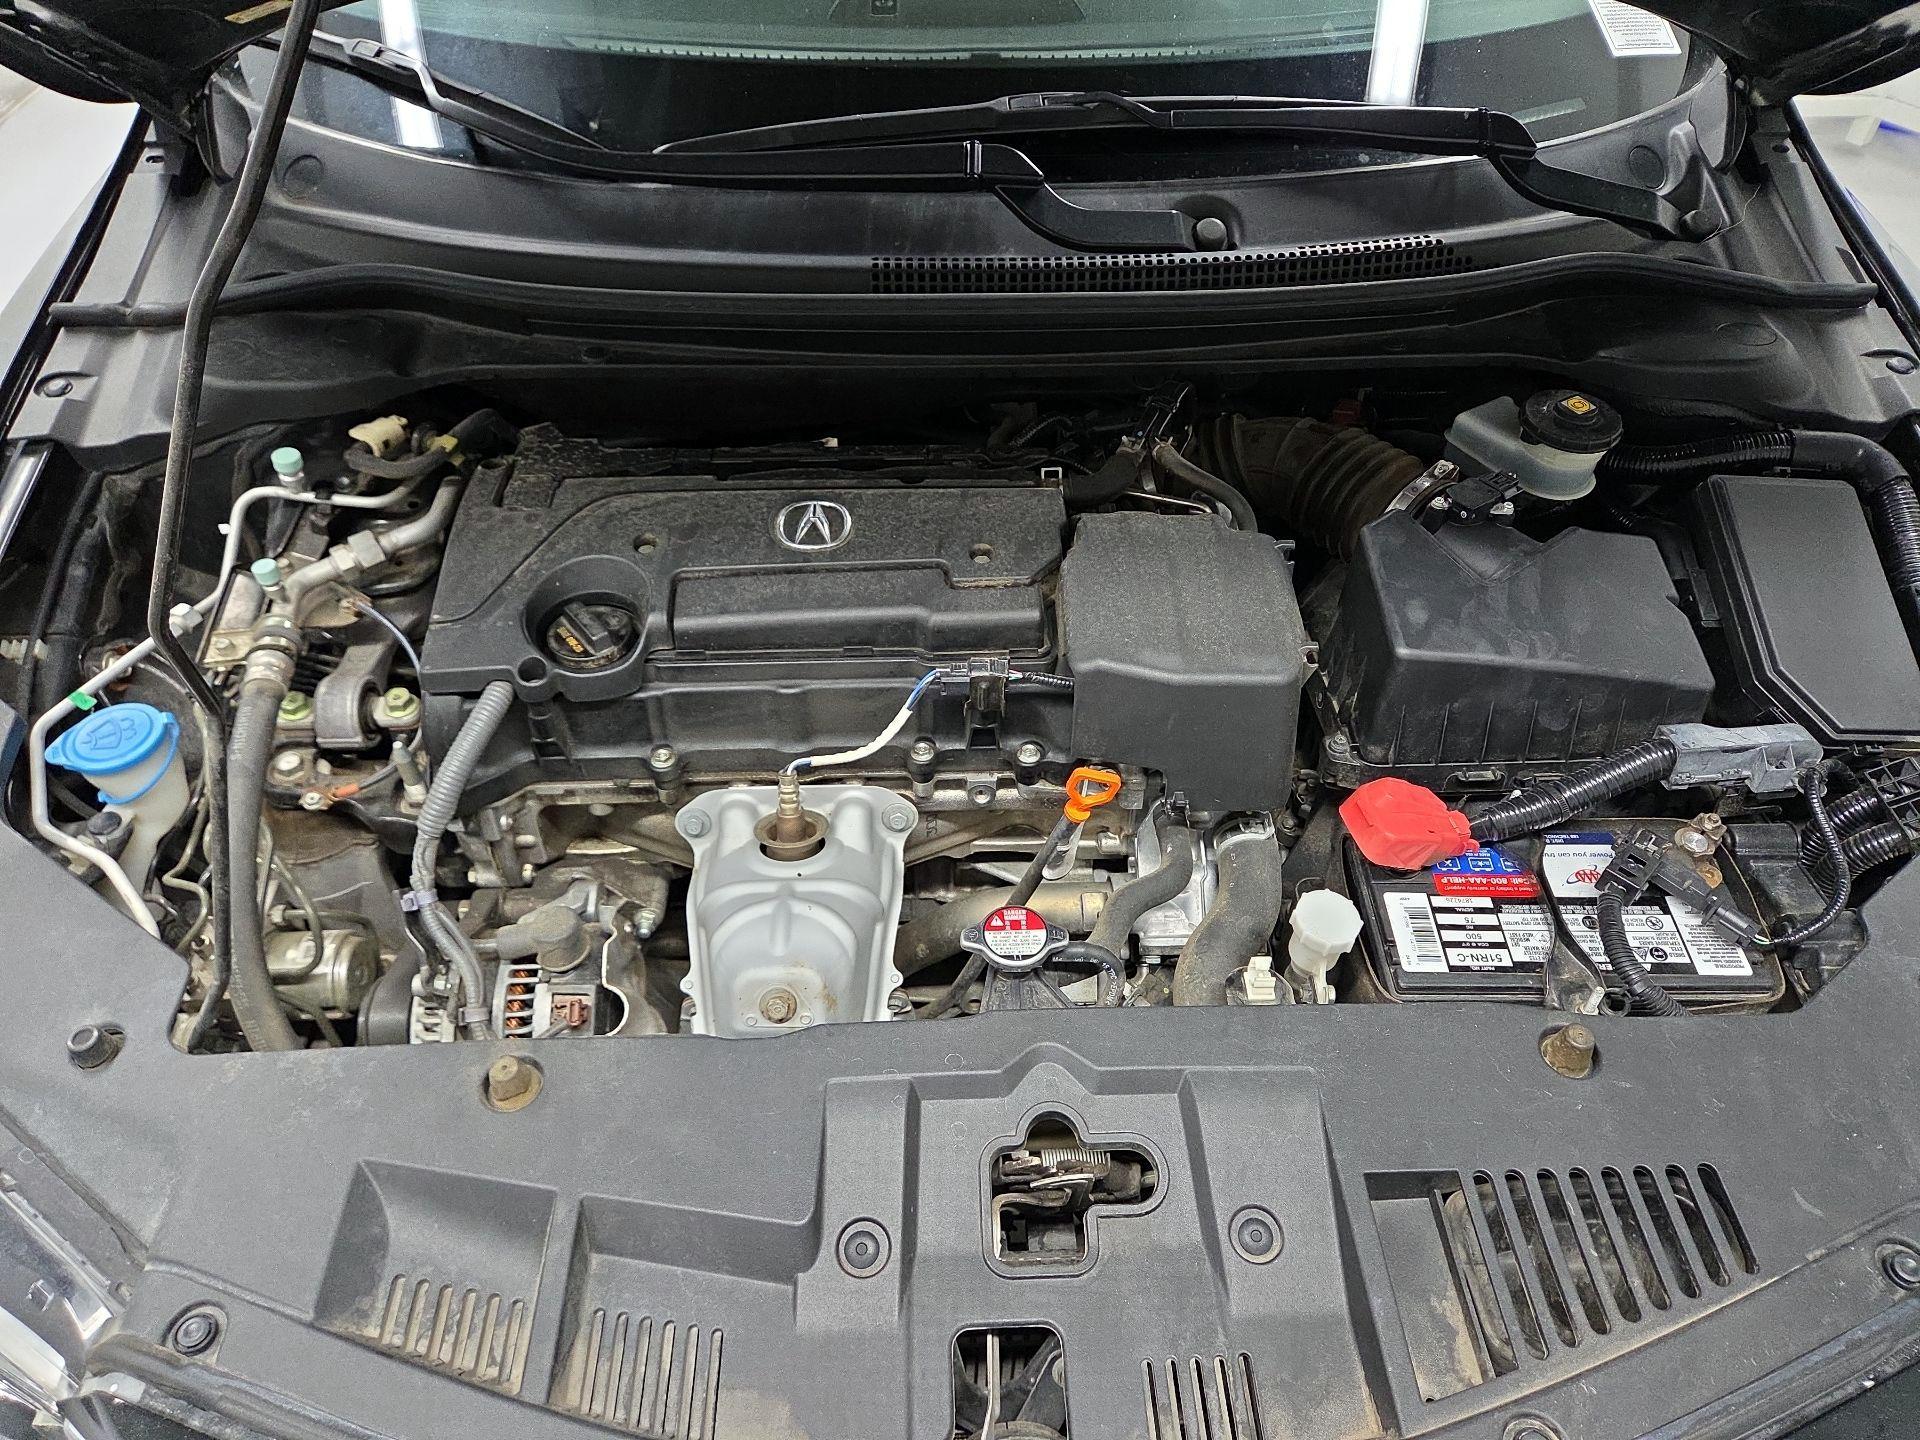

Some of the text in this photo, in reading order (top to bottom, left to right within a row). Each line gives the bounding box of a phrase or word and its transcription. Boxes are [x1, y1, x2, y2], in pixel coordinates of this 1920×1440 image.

[1441, 876, 1508, 884] 800-AAA-HELP
[1576, 870, 1600, 883] AAA
[1456, 953, 1502, 962] 51RN-C
